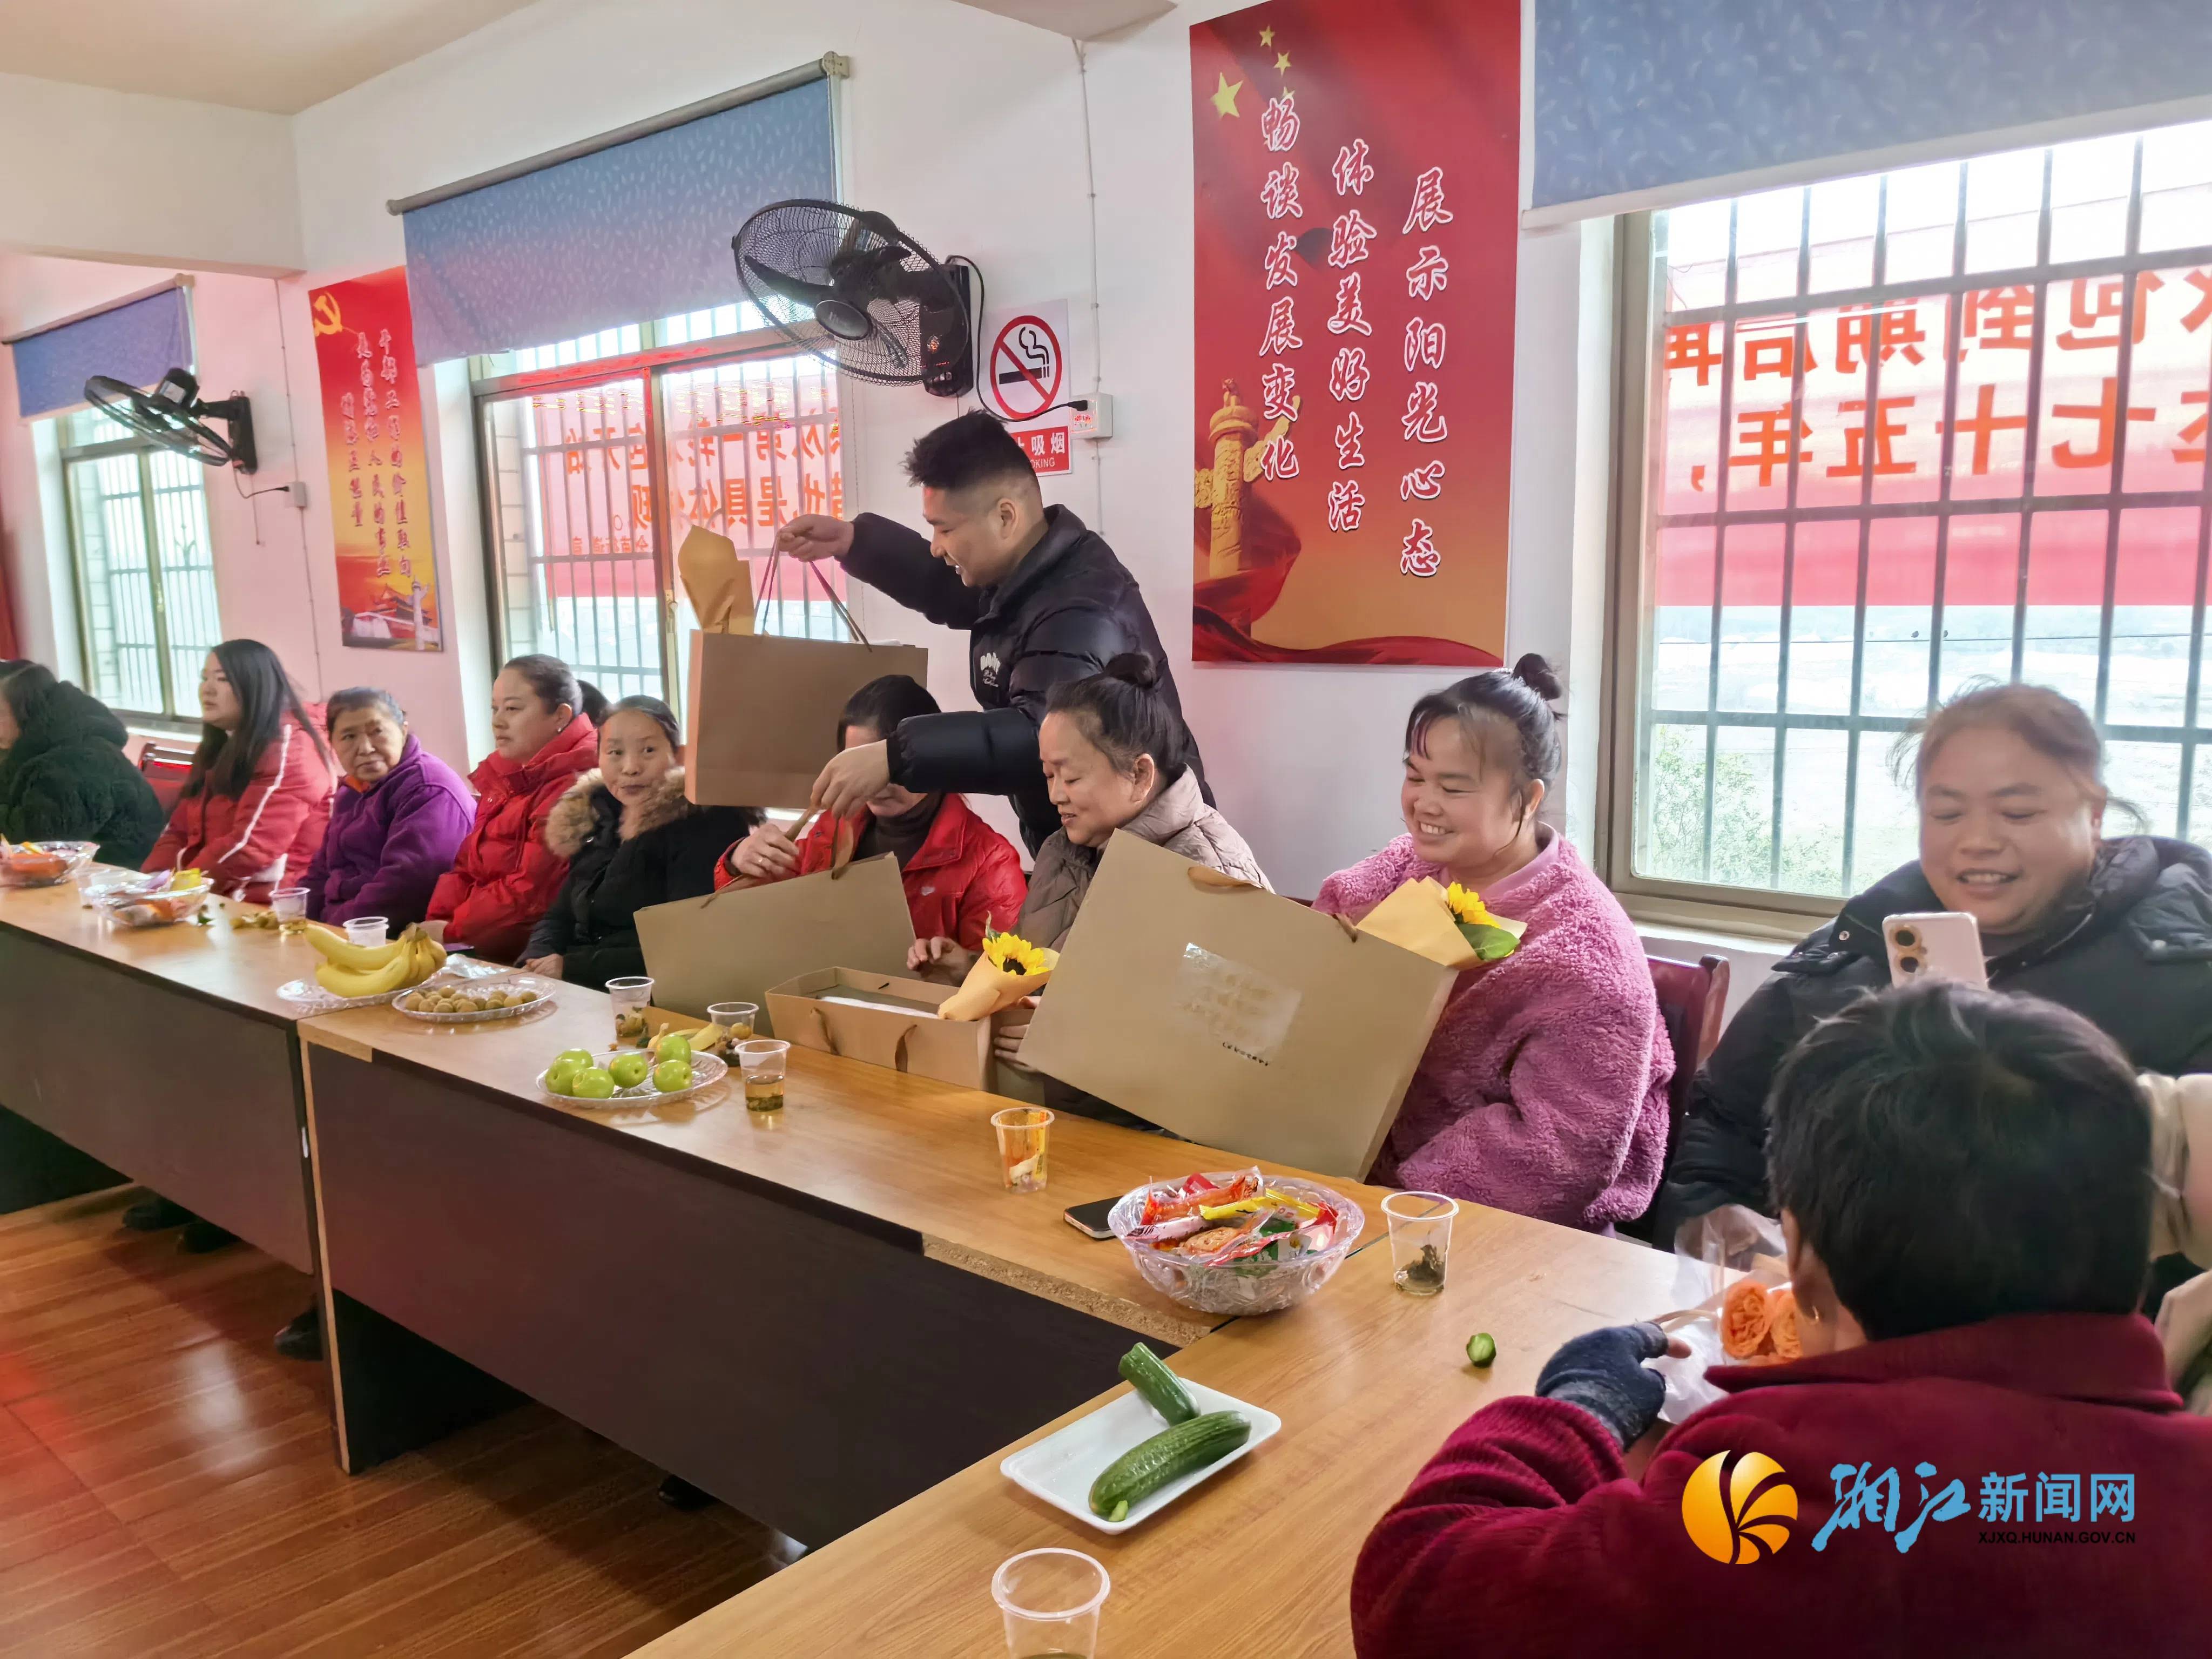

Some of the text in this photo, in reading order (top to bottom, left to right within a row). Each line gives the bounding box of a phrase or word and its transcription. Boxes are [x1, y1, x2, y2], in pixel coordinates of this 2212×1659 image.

[1259, 96, 1303, 482] 畅谈发展变化
[1327, 138, 1377, 532] 体验美好生活
[1400, 166, 1453, 577] 展示阳光心态
